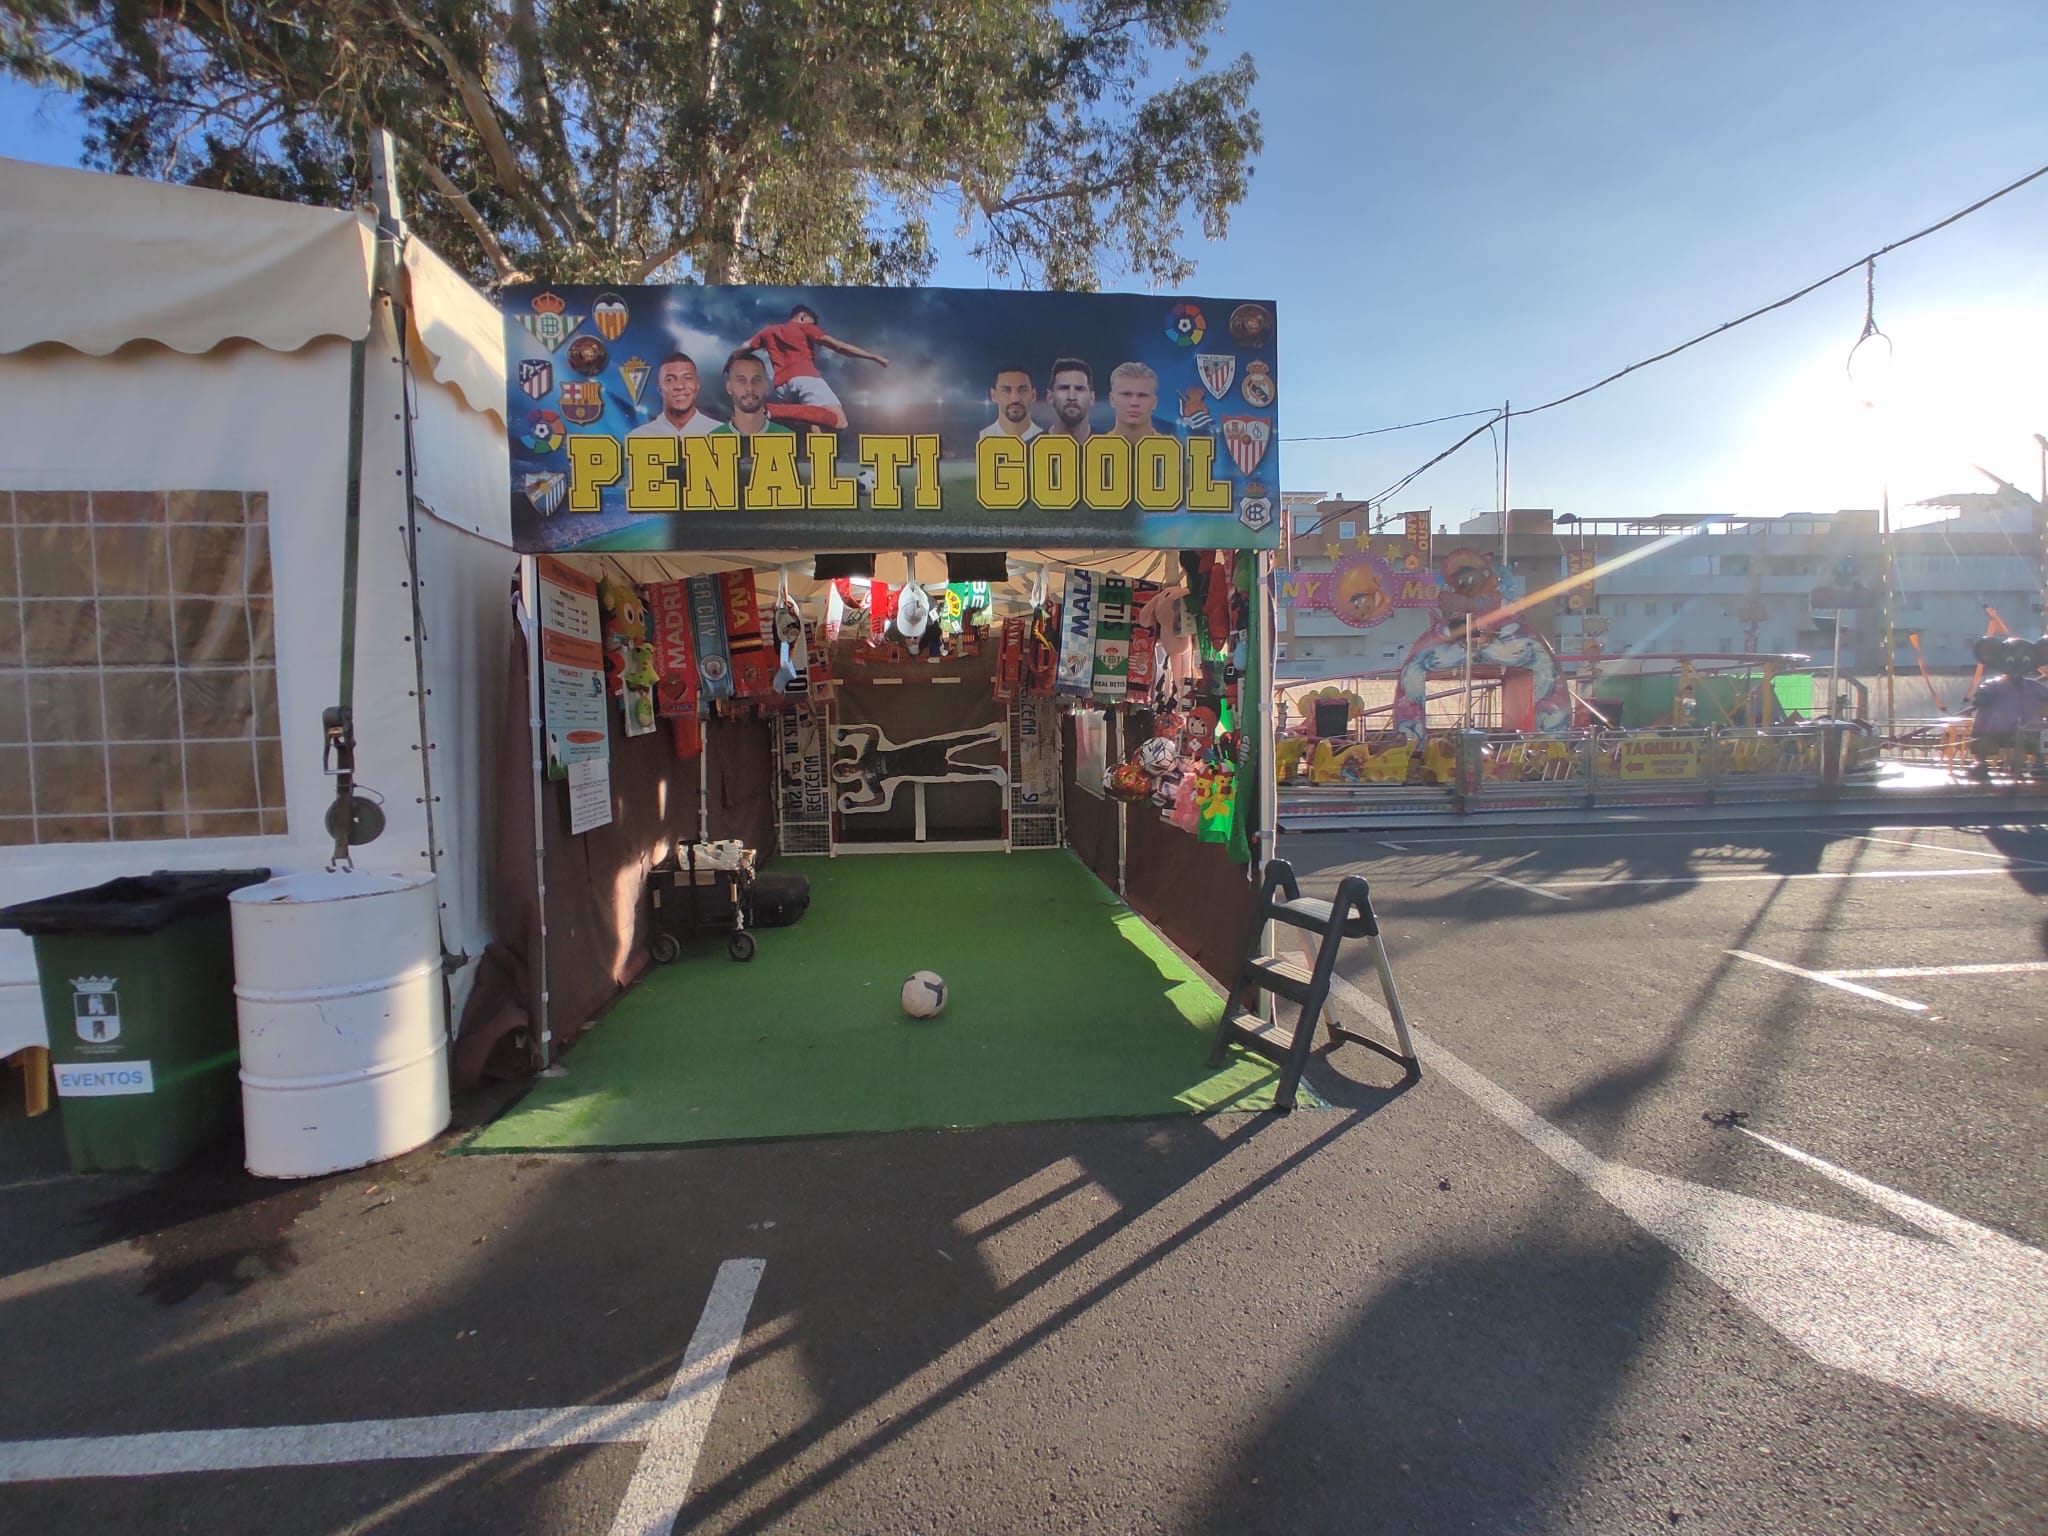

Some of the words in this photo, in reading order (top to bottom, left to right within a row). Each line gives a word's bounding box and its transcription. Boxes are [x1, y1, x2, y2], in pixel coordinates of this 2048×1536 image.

[566, 432, 943, 513] PENALTI
[975, 433, 1234, 513] GOOOL
[1104, 578, 1126, 631] BETIS
[1281, 582, 1321, 598] NY
[1402, 581, 1441, 600] MO
[696, 605, 717, 637] CITY
[1624, 741, 1695, 755] TAQUILLA
[803, 755, 822, 813] BENZEMA
[60, 1071, 144, 1087] EVENTOS
